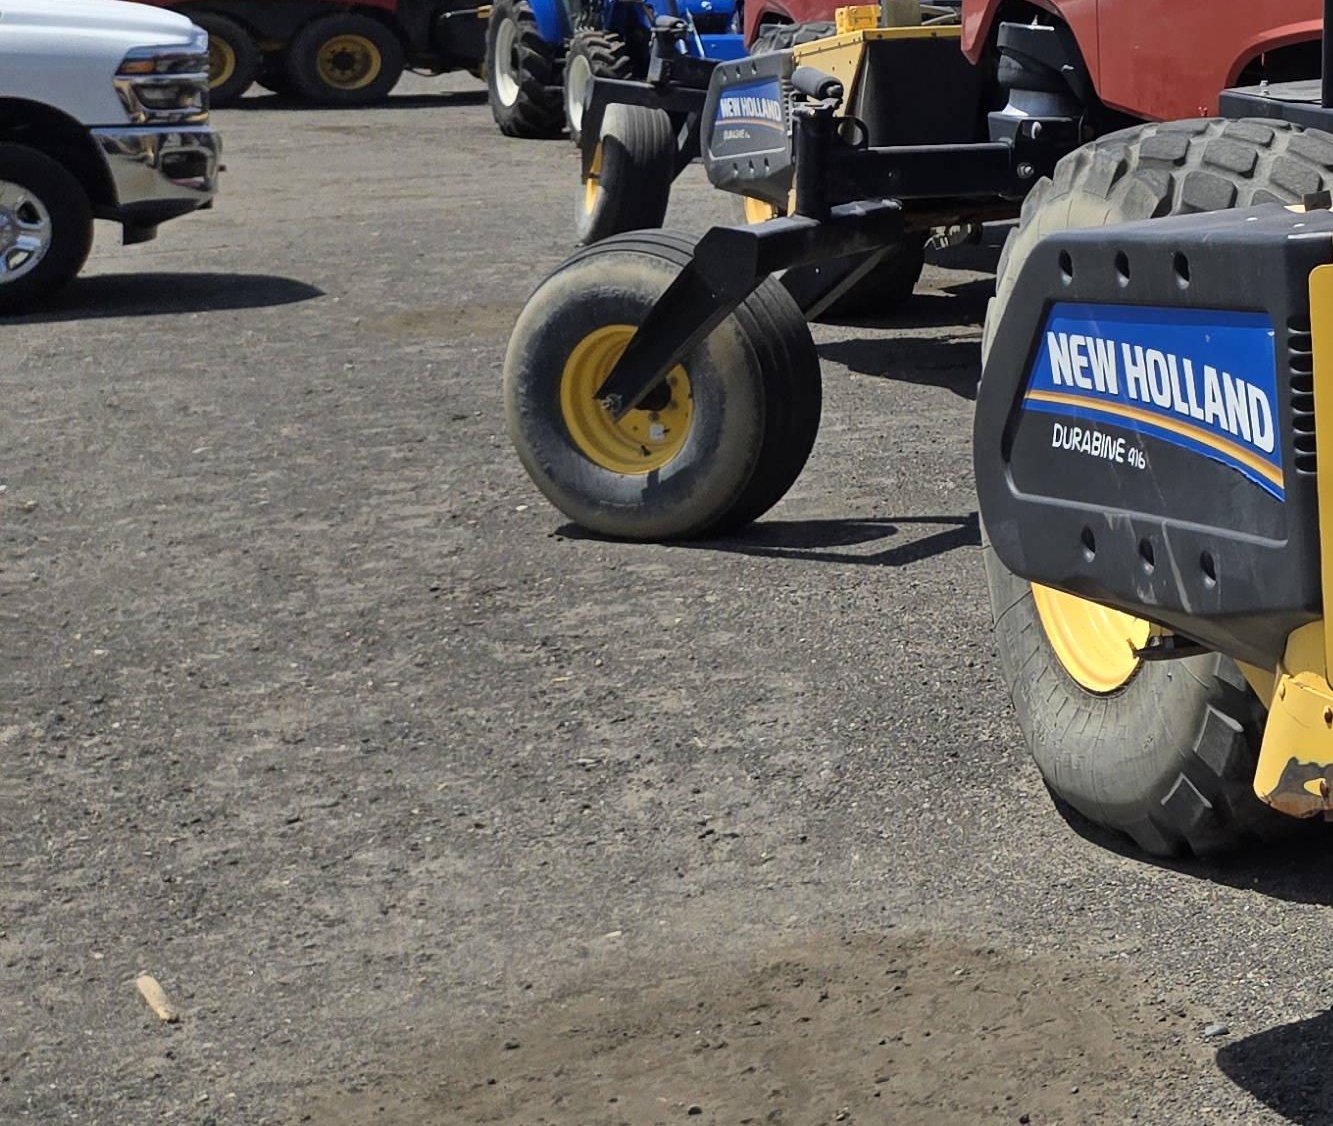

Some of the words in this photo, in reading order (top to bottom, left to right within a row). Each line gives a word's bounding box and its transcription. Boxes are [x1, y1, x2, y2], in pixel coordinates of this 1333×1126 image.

[720, 97, 741, 118] NEW
[740, 97, 782, 122] HOLLAND
[1047, 331, 1119, 396] NEW
[1121, 342, 1275, 454] HOLLAND
[1052, 422, 1126, 463] DURABINE
[1127, 447, 1146, 470] 416
